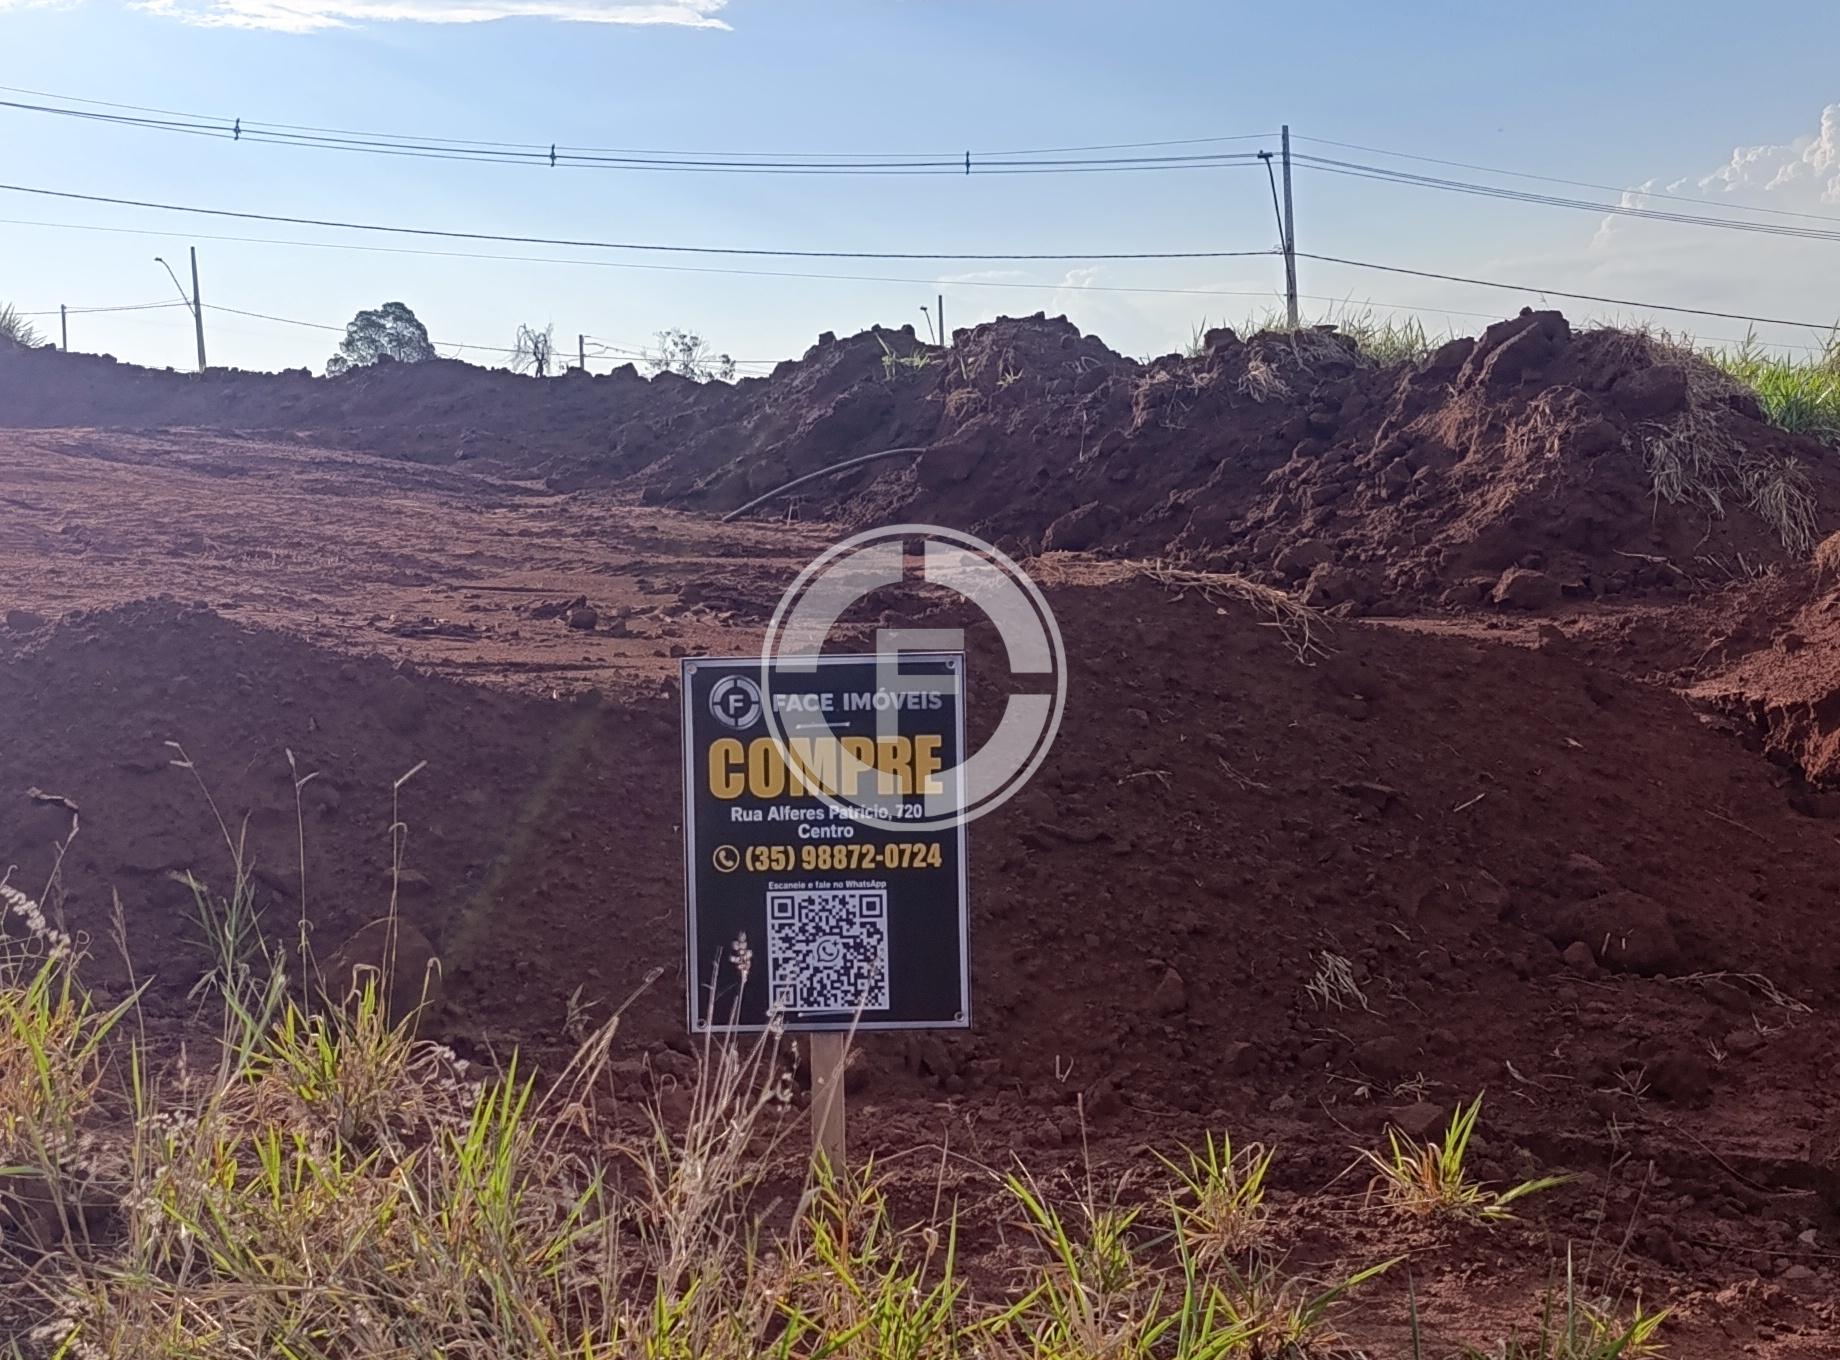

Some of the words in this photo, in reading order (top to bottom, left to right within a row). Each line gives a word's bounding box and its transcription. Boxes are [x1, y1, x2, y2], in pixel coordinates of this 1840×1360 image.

[773, 693, 834, 713] FACE
[843, 687, 943, 711] IMÓVEIS
[708, 735, 944, 800] COMPRE
[731, 807, 763, 821] Rua
[767, 806, 825, 821] Alferes
[897, 804, 922, 819] 720
[798, 823, 854, 839] Centro
[745, 845, 796, 872] (35)
[801, 843, 942, 870] 98872-0724
[768, 881, 806, 890] Escaneie
[815, 881, 831, 889] fale
[845, 880, 887, 889] WhatsApp
